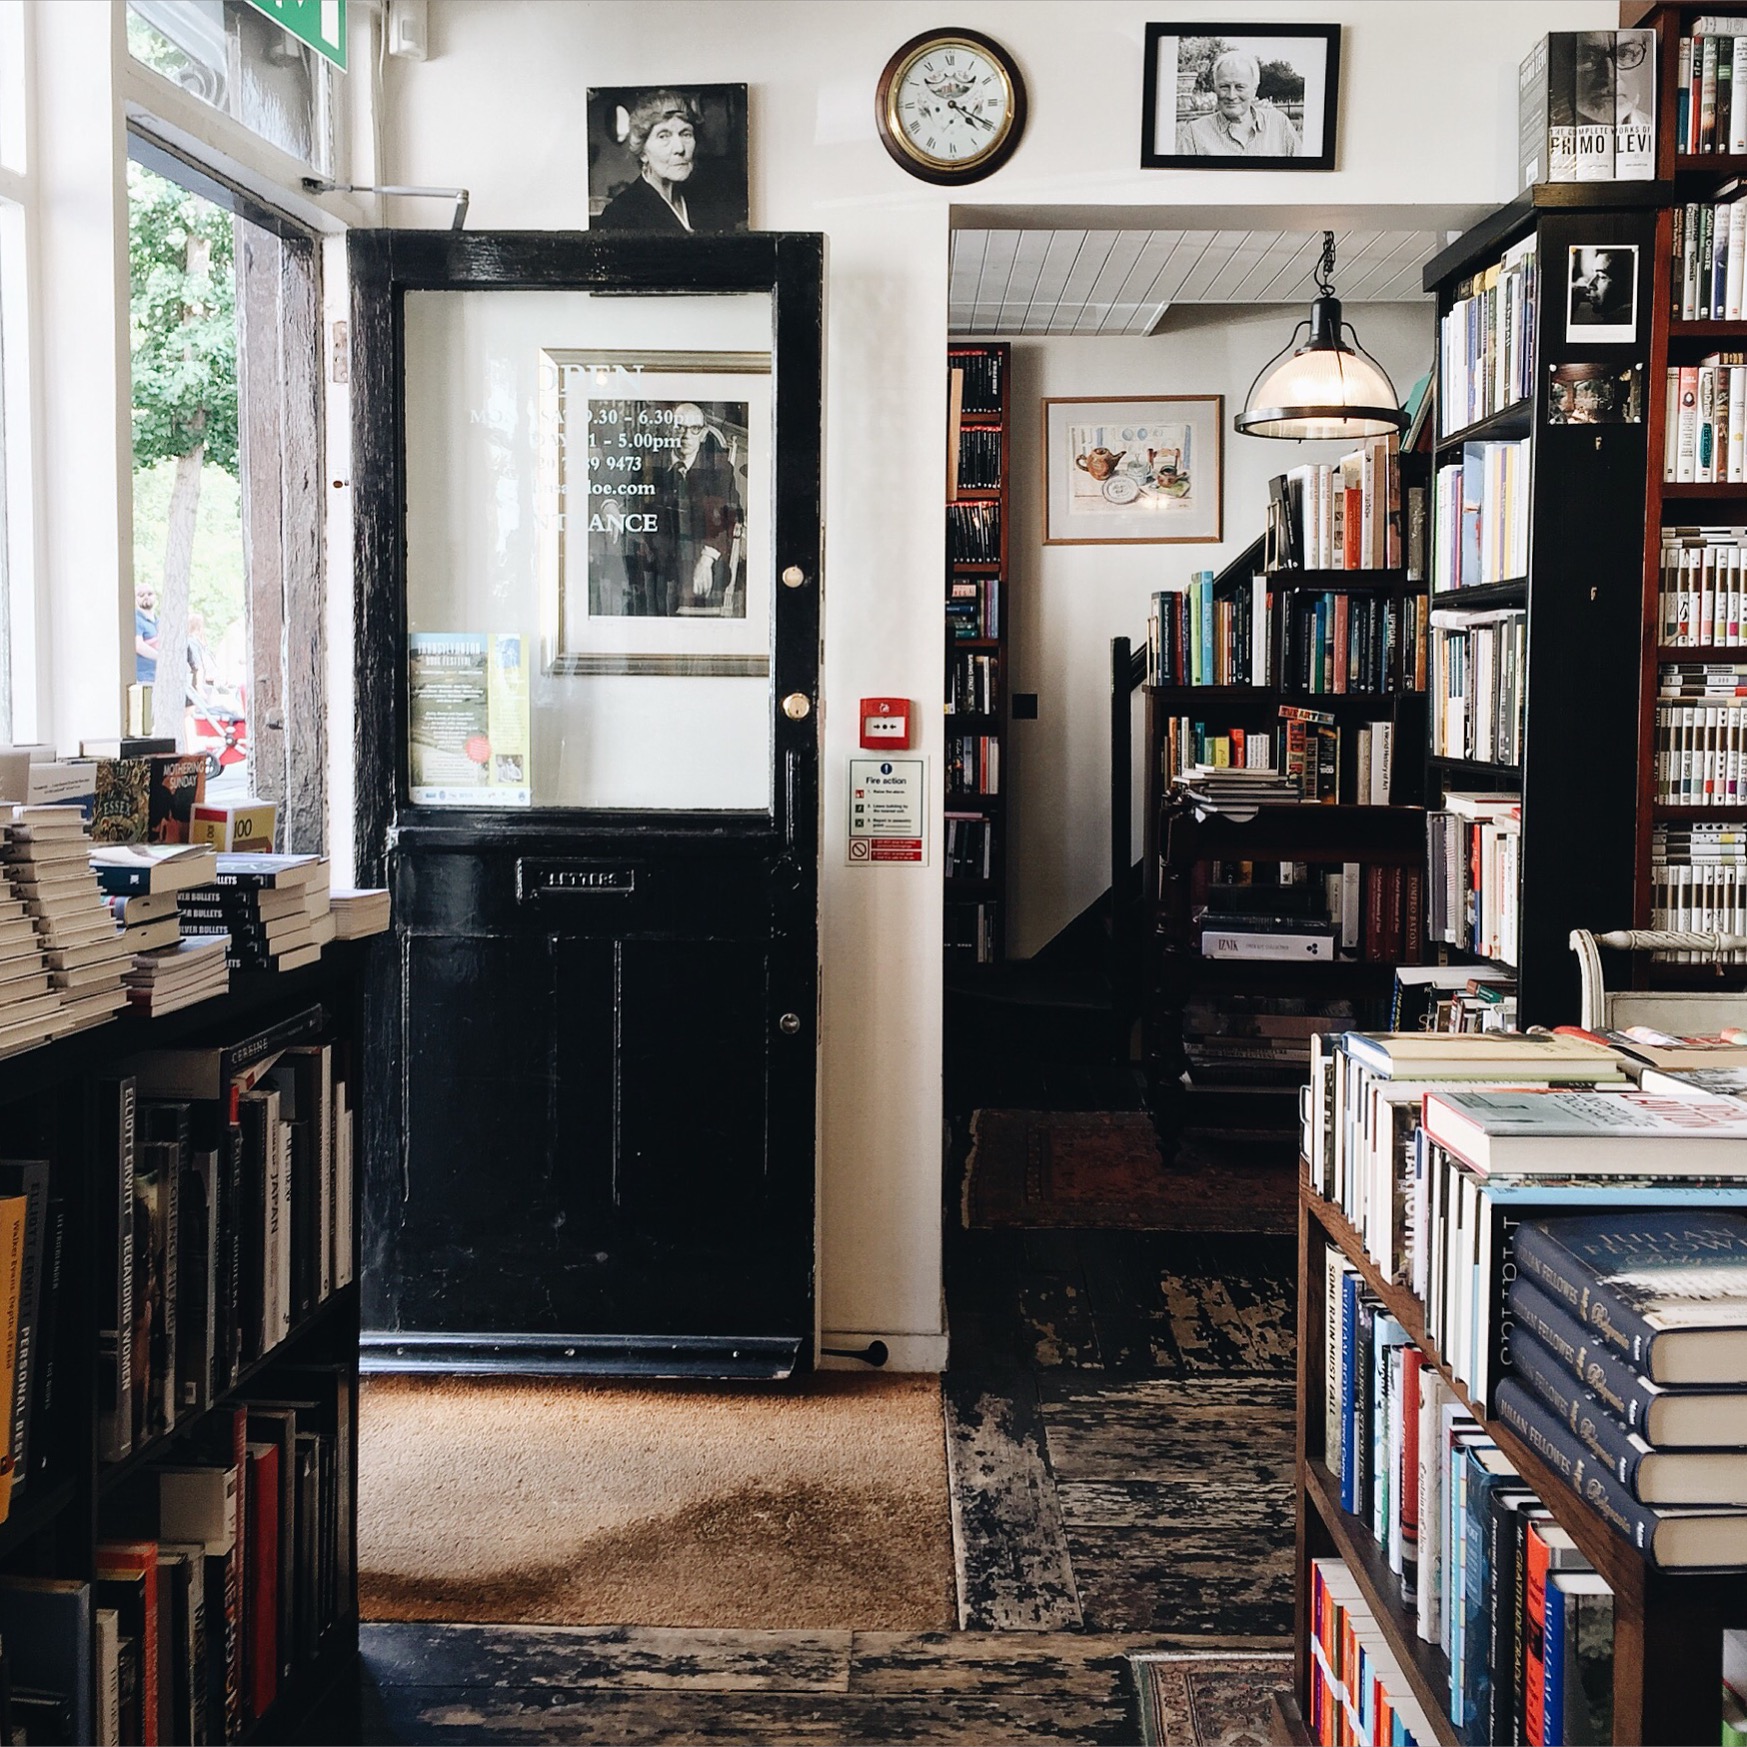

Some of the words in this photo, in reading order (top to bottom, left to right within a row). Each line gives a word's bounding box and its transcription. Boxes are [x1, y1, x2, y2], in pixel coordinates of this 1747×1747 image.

[1551, 134, 1605, 155] PRIMO
[1616, 134, 1652, 154] LEVI
[1568, 126, 1608, 136] COMPLETE
[1610, 126, 1640, 135] WORKS
[538, 364, 645, 392] OPEN
[639, 410, 704, 428] 6.30pm
[618, 434, 683, 452] 5.00pm
[606, 456, 642, 472] 9473
[163, 760, 204, 776] MOTHERING
[170, 775, 198, 789] SUNDAY
[866, 776, 881, 785] Fire
[883, 777, 907, 785] action
[104, 800, 132, 817] ESSEX
[232, 818, 253, 838] 100
[217, 876, 238, 886] LLETS
[191, 892, 221, 902] BULLETS
[193, 910, 223, 918] BULLETS
[200, 926, 229, 934] BULLETS
[124, 1087, 135, 1150] ELLIOTT
[122, 1154, 134, 1217] ERWITT
[270, 1173, 279, 1235] JAPAN
[10, 1220, 20, 1258] Walker
[122, 1234, 133, 1325] REGARDING
[1328, 1264, 1336, 1303] SOME
[1328, 1305, 1336, 1341] RAIN
[16, 1325, 31, 1416] PERSONAL
[121, 1328, 132, 1391] WOMEN
[1328, 1343, 1336, 1381] MUST
[1328, 1384, 1336, 1416] FALL
[14, 1420, 25, 1463] BEST
[1500, 1398, 1528, 1435] JULIAN
[1529, 1424, 1572, 1476] FELLOWES
[1515, 1549, 1524, 1633] GRATITUDE
[1544, 1602, 1553, 1703] WILLIAM
